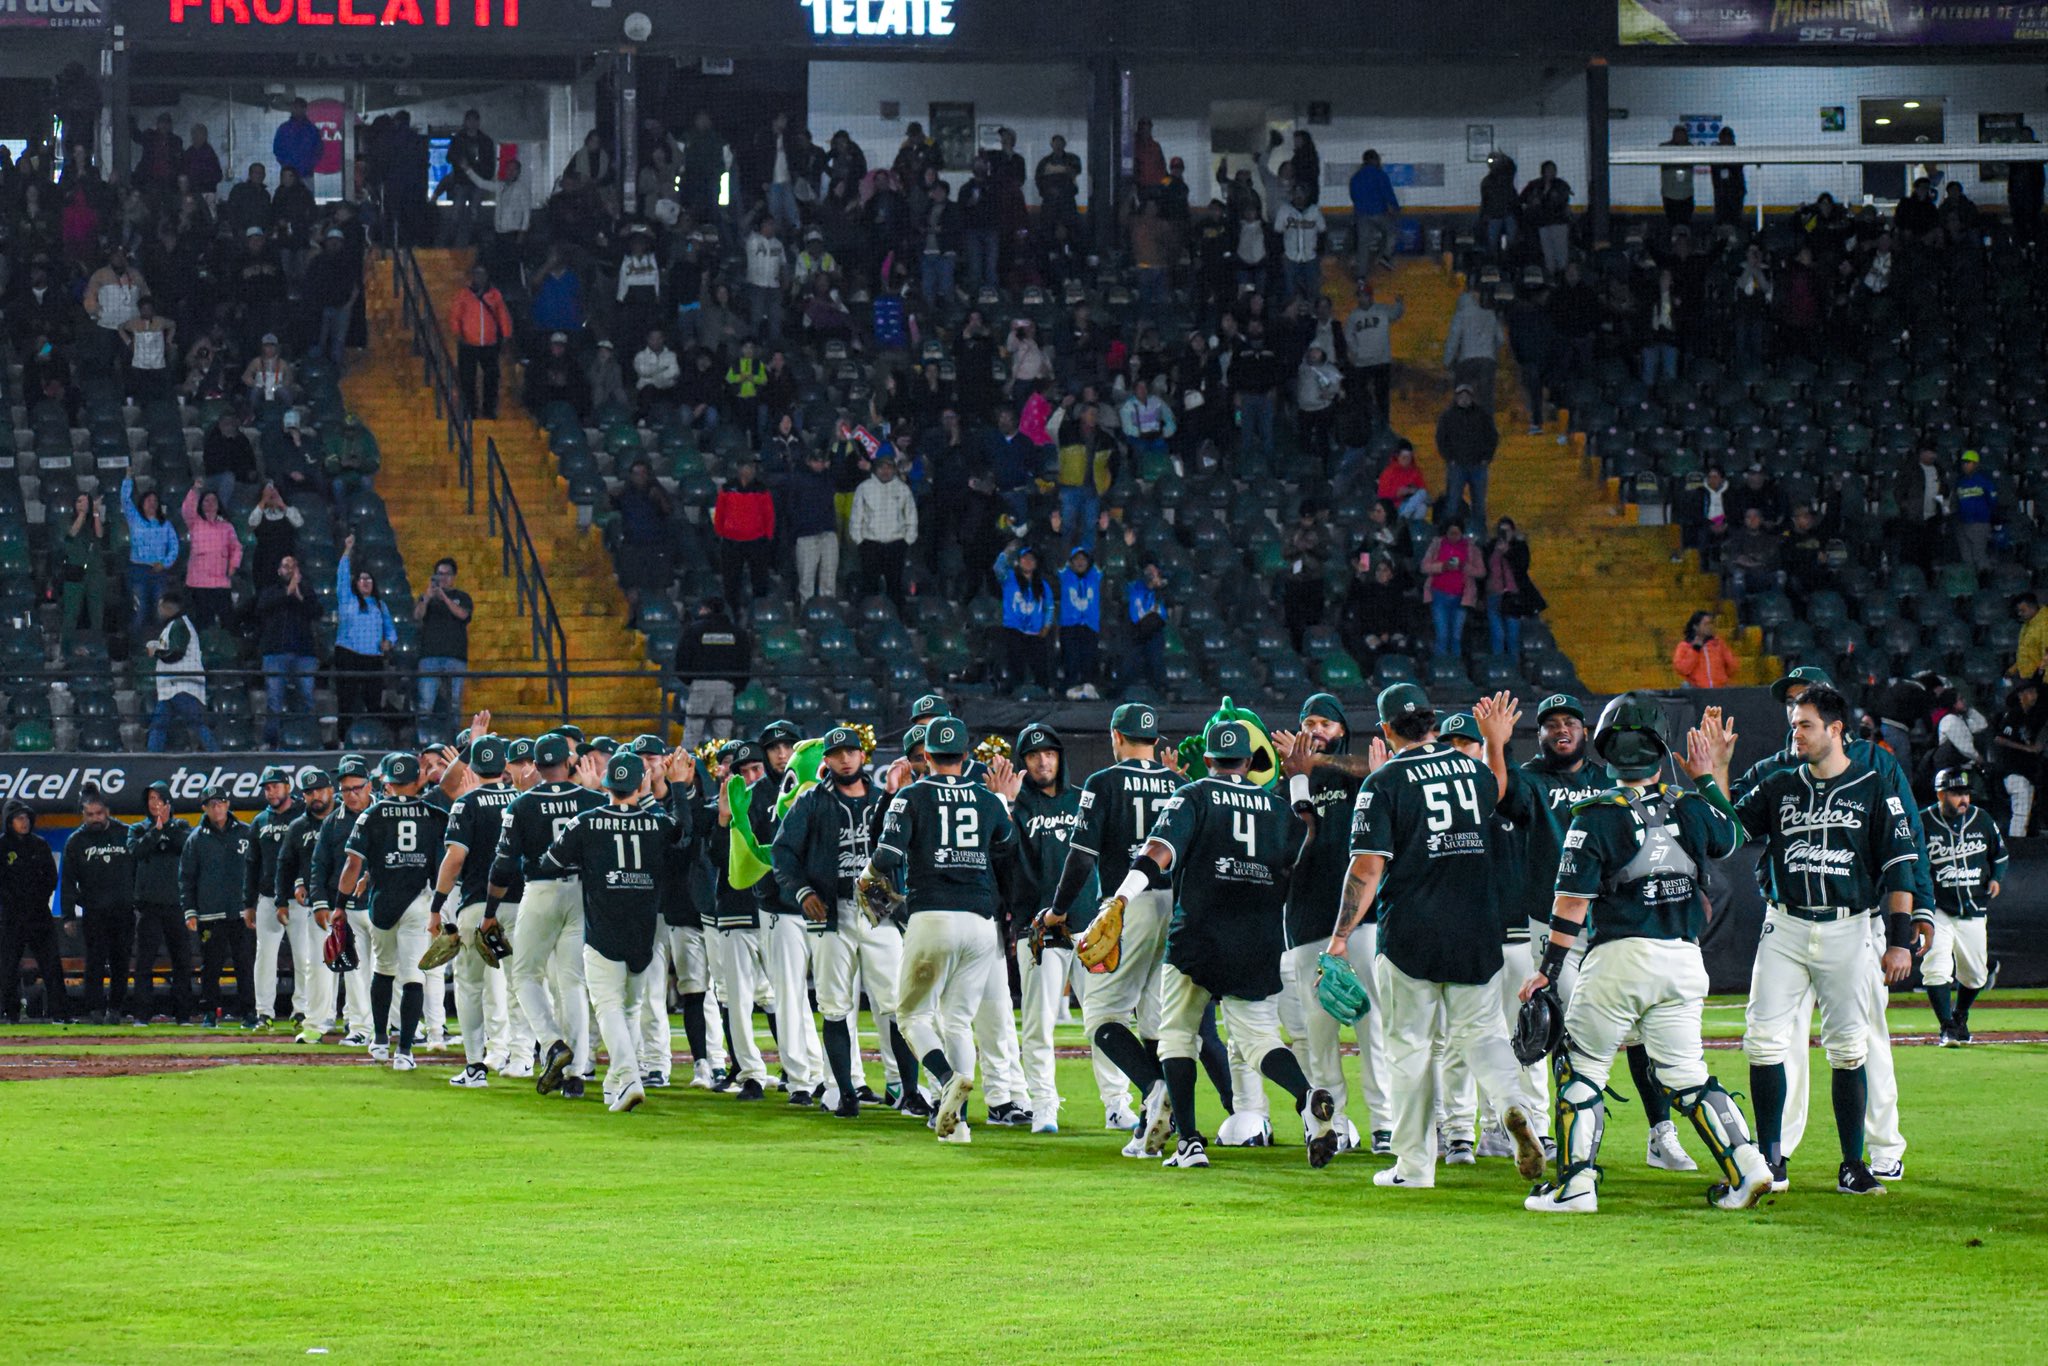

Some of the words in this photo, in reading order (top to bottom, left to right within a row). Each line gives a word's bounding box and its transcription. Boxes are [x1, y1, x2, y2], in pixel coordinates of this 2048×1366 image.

[50, 17, 102, 27] GERMANY
[800, 0, 956, 35] TECATE
[1799, 26, 1856, 42] 95.5
[1405, 758, 1477, 783] ALVARADO
[1123, 776, 1176, 793] ADAMES
[476, 791, 520, 807] MUZZIO
[936, 788, 977, 802] LEYVA
[1211, 790, 1272, 811] SANTANA
[381, 806, 430, 818] CEDROLA
[540, 799, 578, 814] ERVIN
[1422, 778, 1482, 832] 54
[588, 817, 660, 832] TORREALBA
[938, 805, 979, 848] 12
[1779, 803, 1862, 837] Pericos
[397, 820, 417, 852] 8
[1232, 810, 1256, 857] 4
[613, 833, 642, 870] 11
[1233, 860, 1269, 872] CHRISTUS
